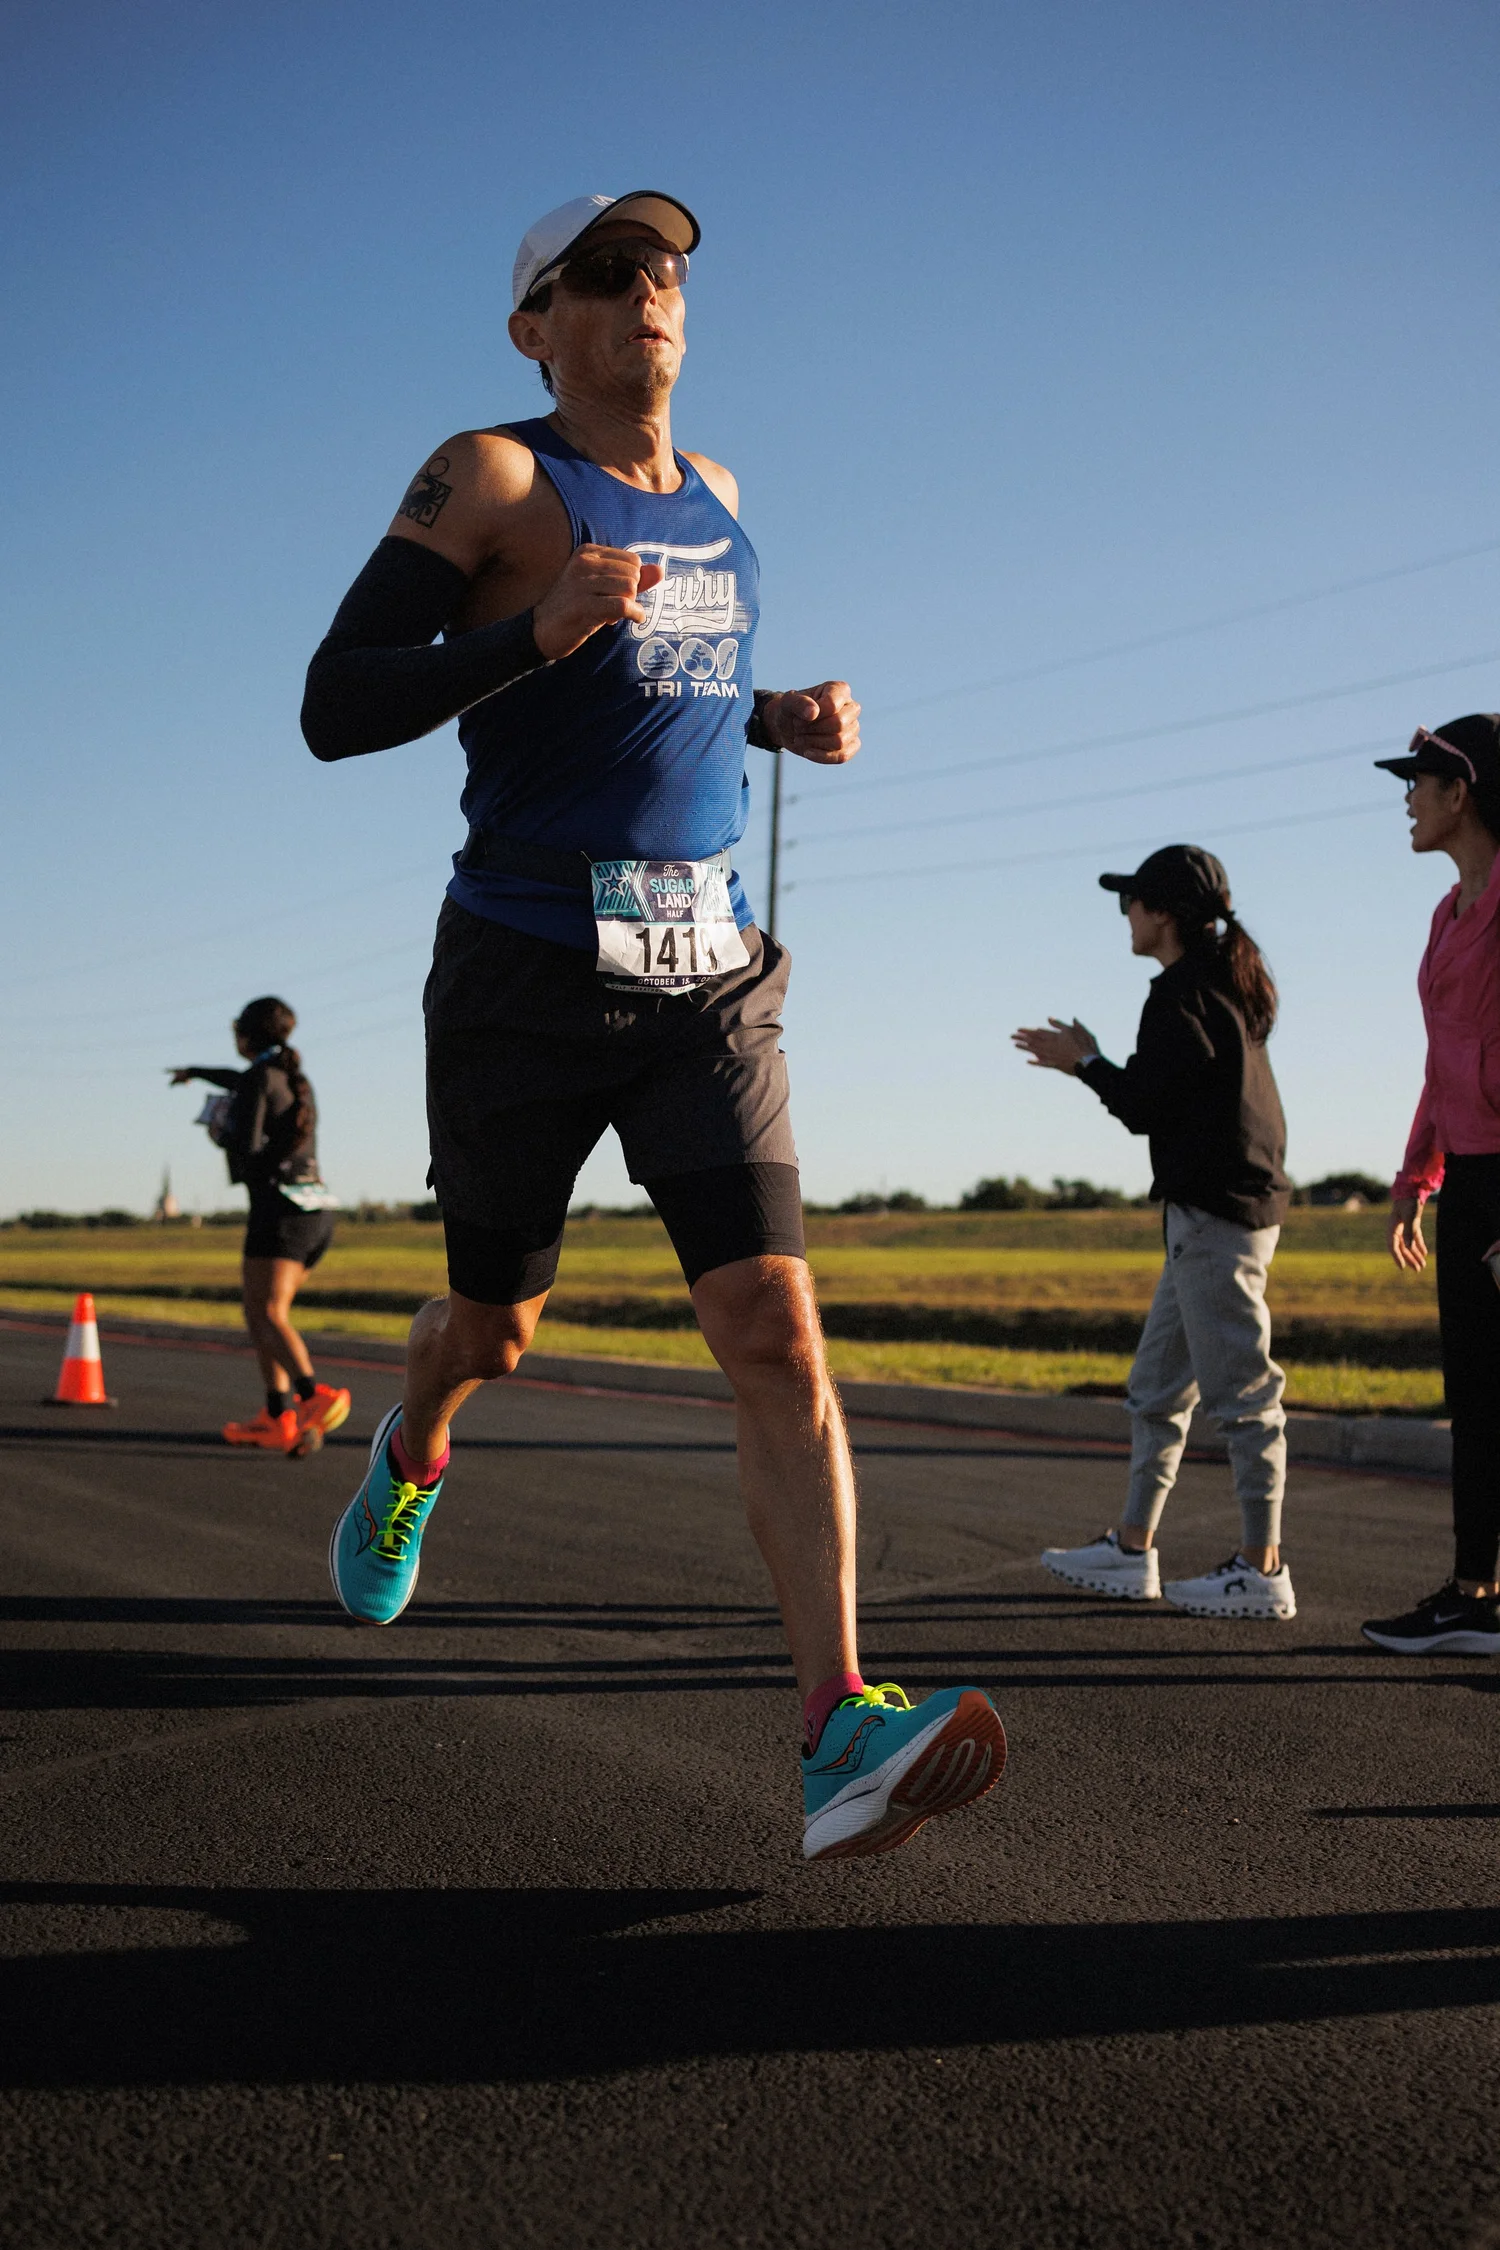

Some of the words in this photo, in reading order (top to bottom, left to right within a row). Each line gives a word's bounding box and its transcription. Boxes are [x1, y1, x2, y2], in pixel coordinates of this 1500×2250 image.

[624, 537, 737, 641] Fury
[638, 681, 682, 698] TRI
[690, 680, 740, 698] TEAM
[663, 864, 680, 879] The
[649, 878, 695, 894] SUGAR
[656, 893, 692, 909] LAND
[666, 909, 684, 918] HALF
[637, 977, 676, 986] OCTOBER
